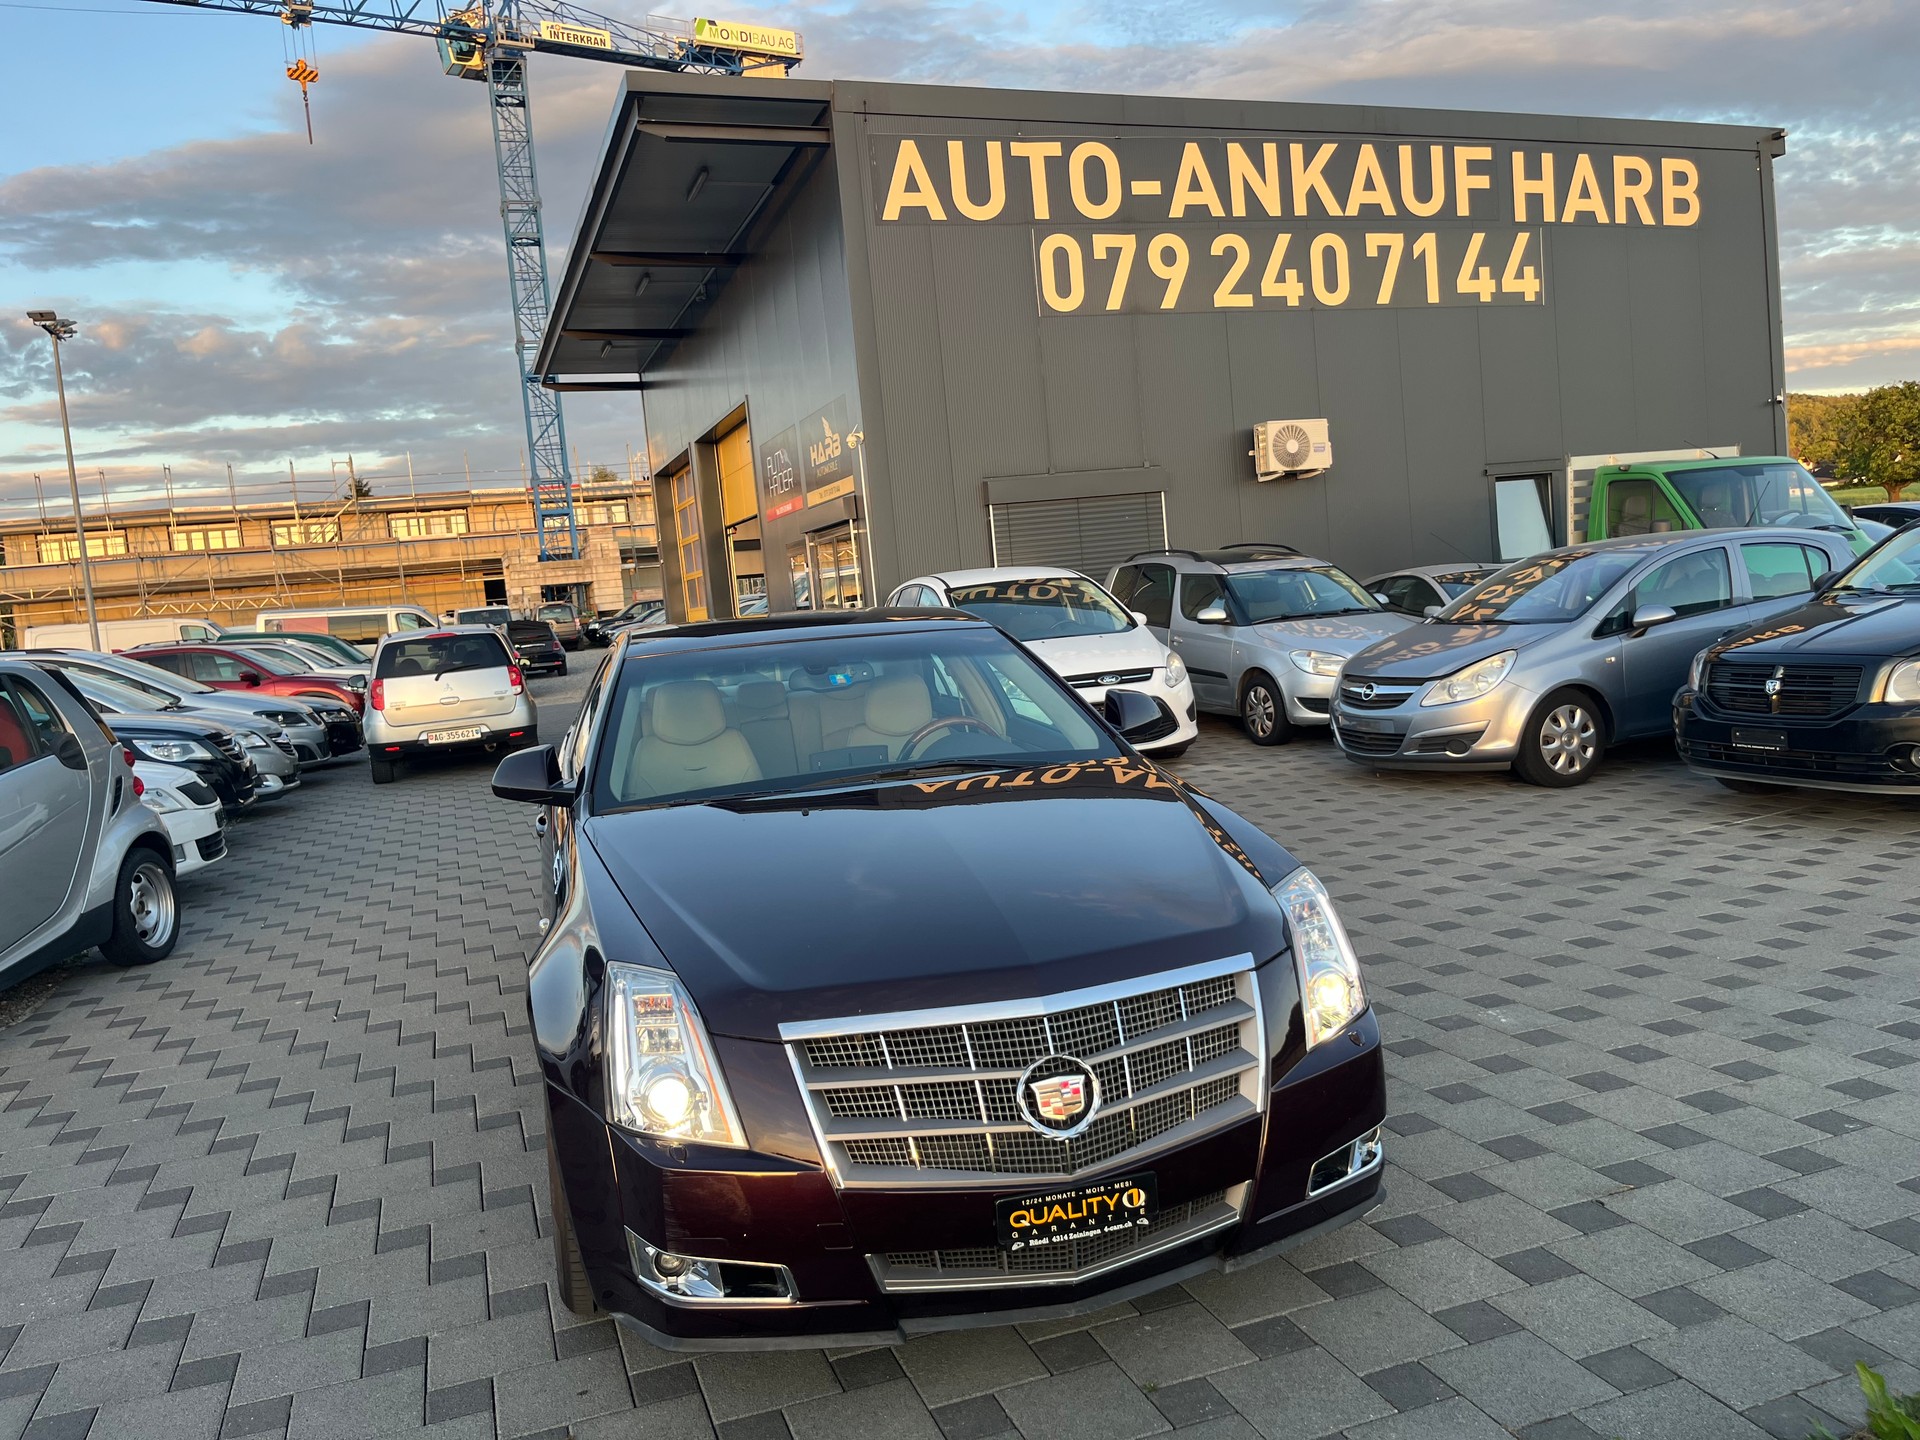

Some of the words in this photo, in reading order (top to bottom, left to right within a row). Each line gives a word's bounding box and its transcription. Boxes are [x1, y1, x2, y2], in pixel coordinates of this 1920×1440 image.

[549, 30, 606, 47] INTERKRAN
[709, 27, 775, 46] MONDIBAU
[778, 36, 794, 49] AG
[882, 139, 1492, 221] AUTO-ANKAUF
[1511, 151, 1700, 227] HARB
[1039, 233, 1190, 312] 079
[1210, 233, 1350, 307] 240
[1365, 232, 1439, 305] 71
[1456, 232, 1540, 303] 44
[809, 433, 842, 468] HARB
[1010, 1193, 1119, 1228] QUALITY
[1022, 1197, 1042, 1206] 12/24
[1045, 1191, 1076, 1202] MONATE
[1085, 1185, 1105, 1194] MOIS
[1114, 1180, 1132, 1189] MESI
